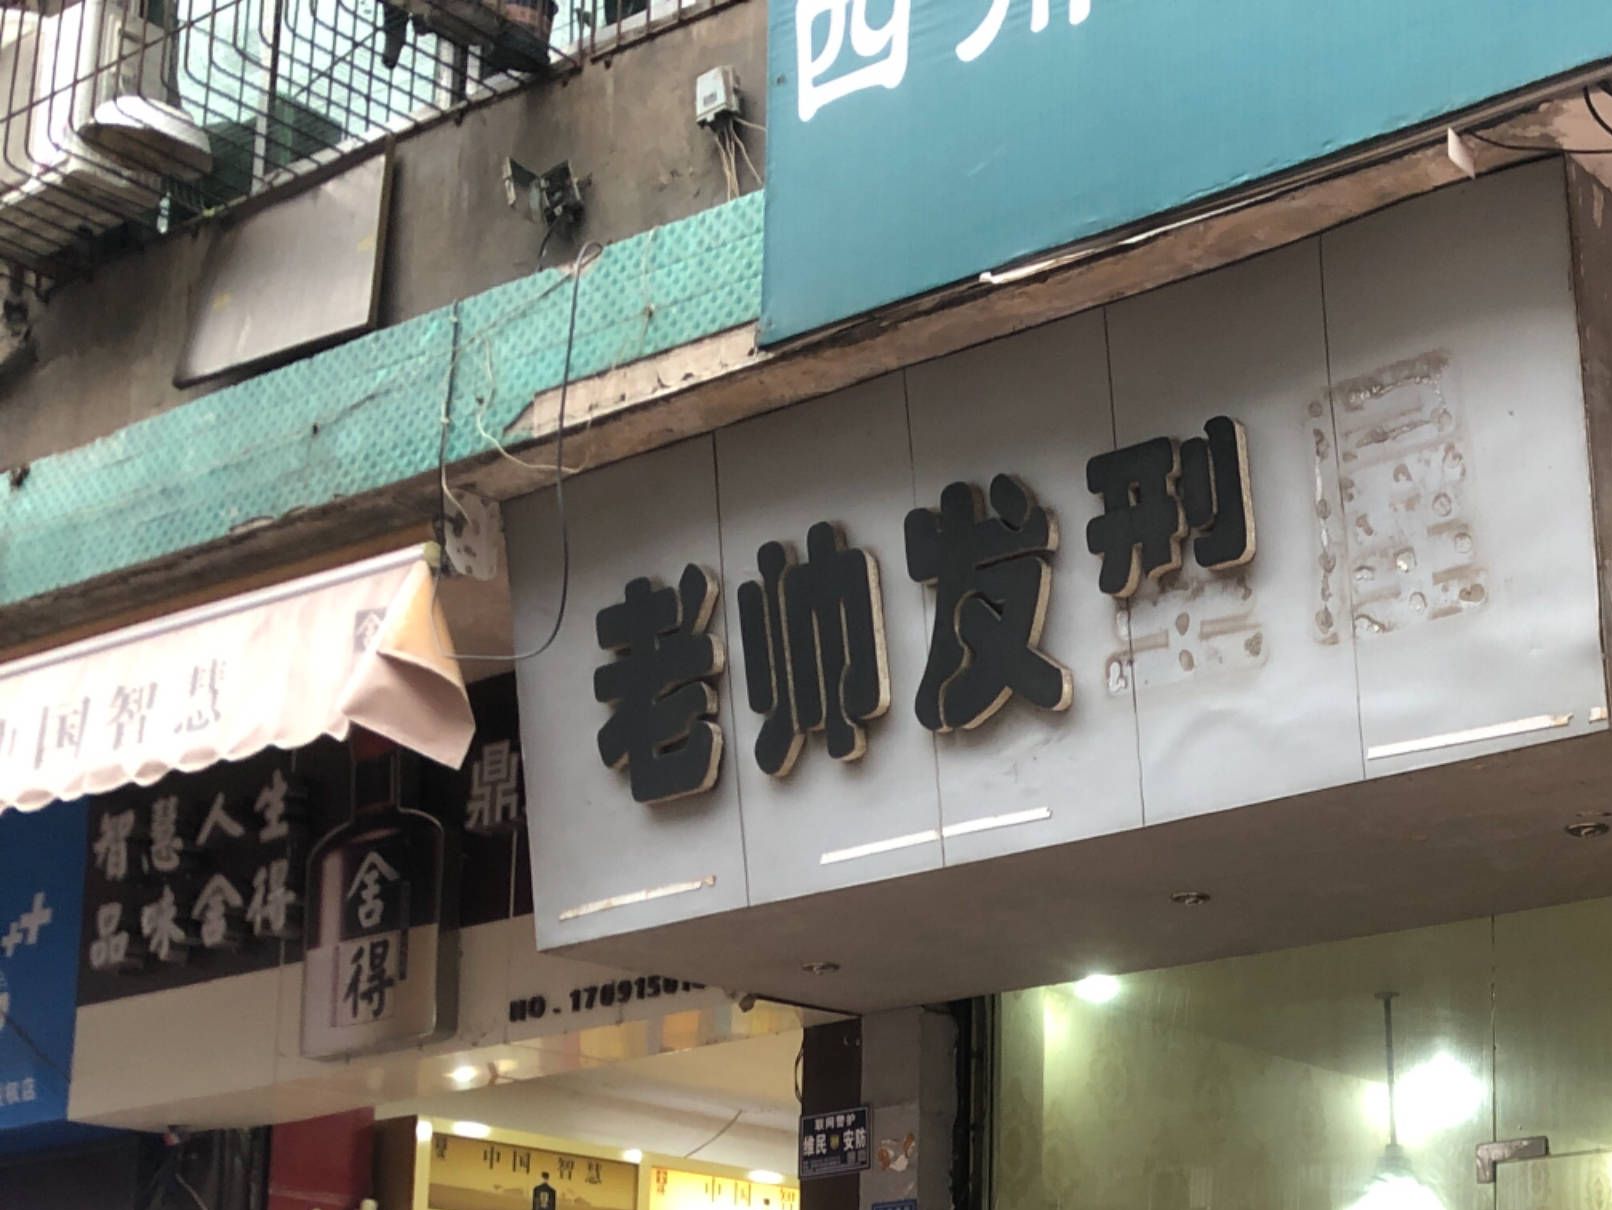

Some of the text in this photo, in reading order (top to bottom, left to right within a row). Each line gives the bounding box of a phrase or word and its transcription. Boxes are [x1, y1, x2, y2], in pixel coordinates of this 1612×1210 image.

[94, 768, 290, 880] 智慧人生
[89, 858, 297, 969] 品味舍得
[346, 851, 400, 1019] 舍得
